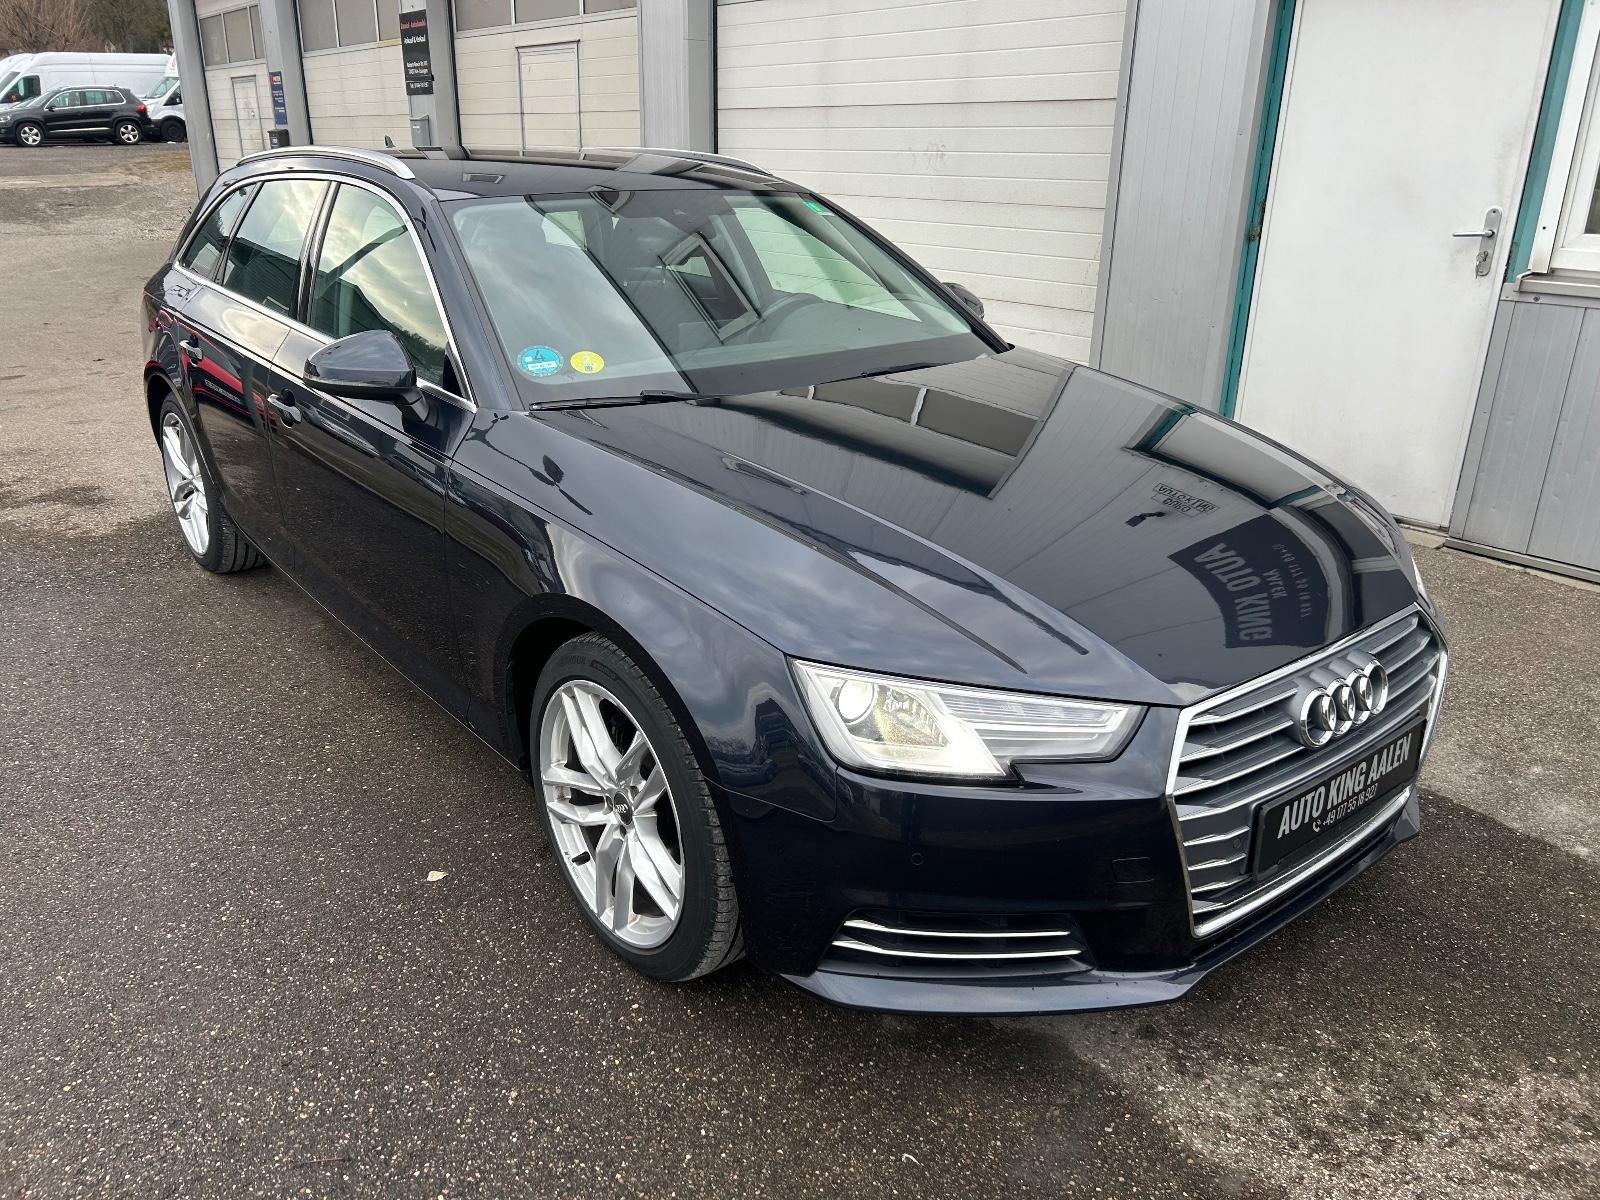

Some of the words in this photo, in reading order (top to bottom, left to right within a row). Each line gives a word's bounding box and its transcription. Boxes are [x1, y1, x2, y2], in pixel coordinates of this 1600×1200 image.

[1277, 786, 1326, 839] AUTO
[1326, 762, 1367, 810] KING
[1367, 733, 1412, 784] AALEN
[1347, 797, 1358, 813] 55
